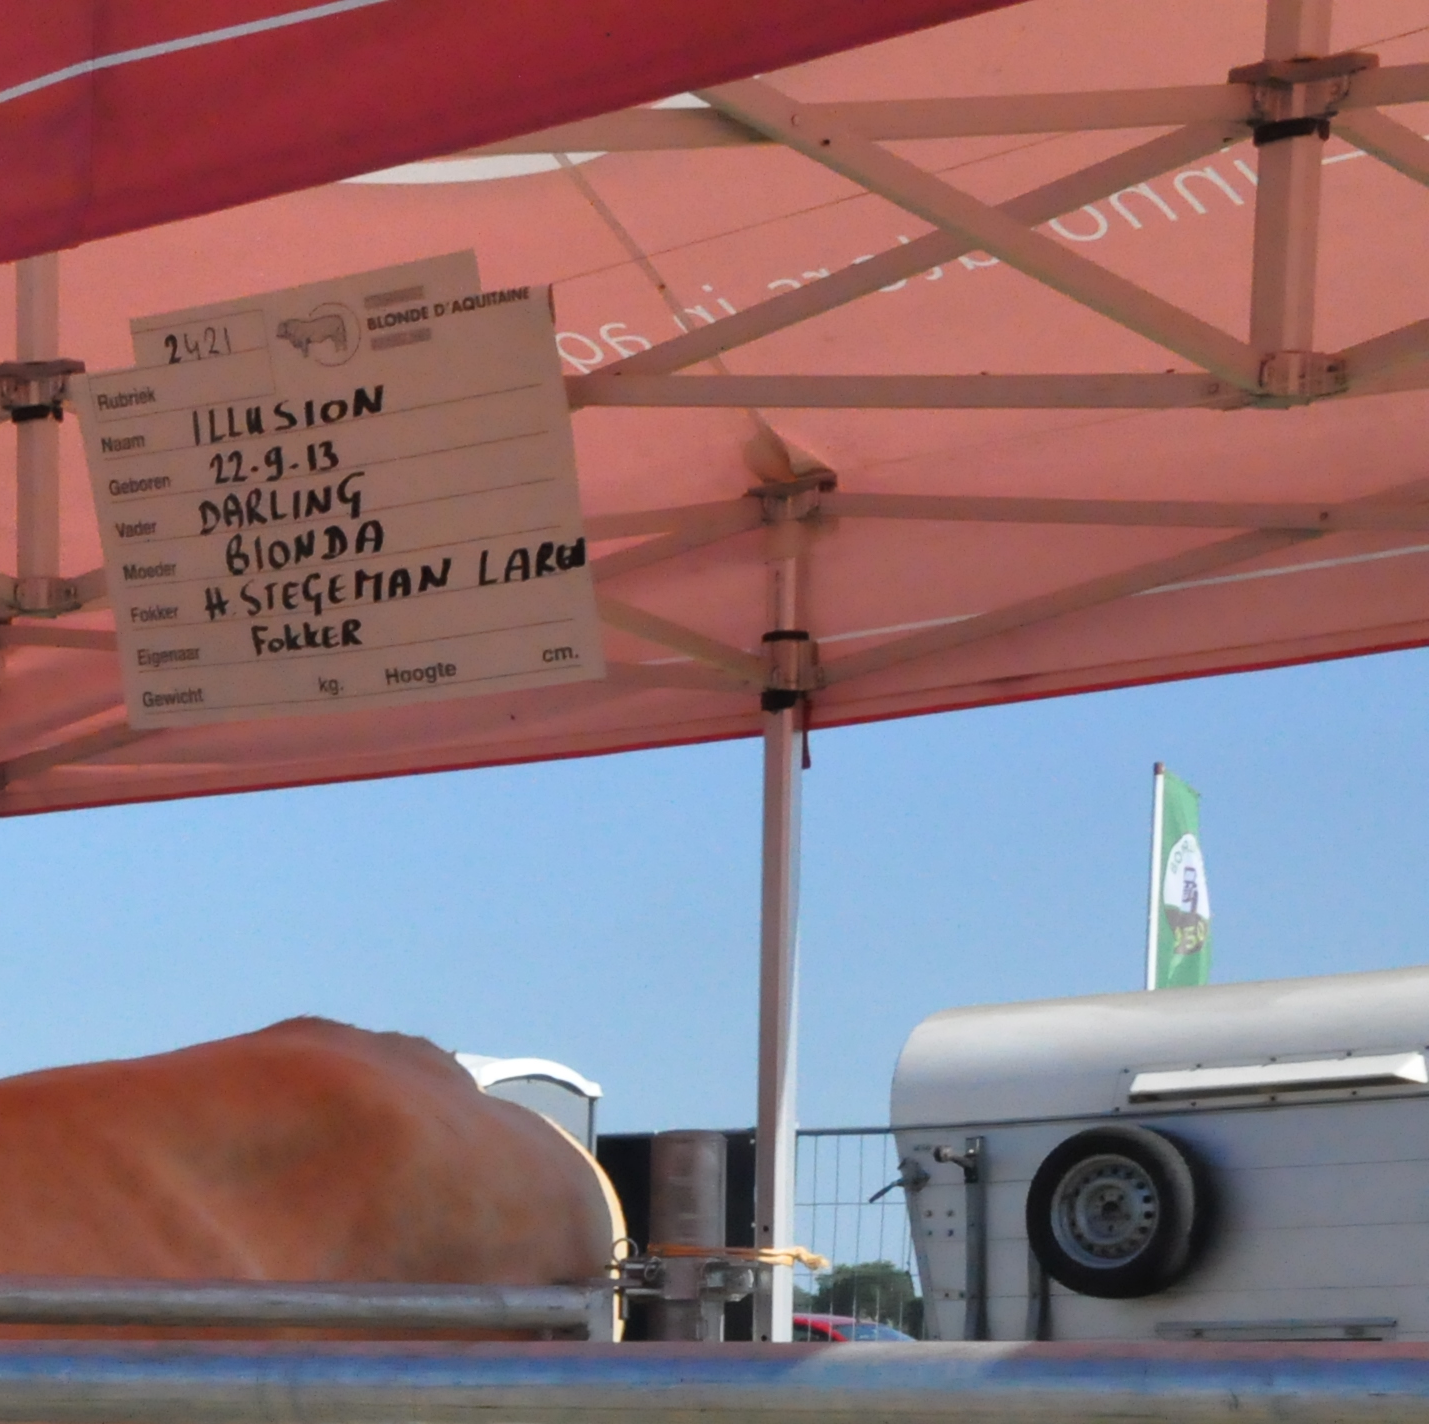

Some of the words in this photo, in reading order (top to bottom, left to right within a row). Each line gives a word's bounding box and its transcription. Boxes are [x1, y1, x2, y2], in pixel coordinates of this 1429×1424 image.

[367, 306, 429, 331] BLONDE
[433, 286, 531, 317] D'AQUITAINE
[164, 326, 232, 364] 2421
[98, 387, 156, 411] Rubriek
[192, 385, 384, 446] ILLUSION
[101, 434, 145, 453] Naam
[109, 474, 171, 496] Geboren
[199, 472, 365, 535] DARLING
[115, 521, 156, 538] Vader
[123, 562, 177, 581] Moeder
[240, 557, 451, 616] STEGEMAN
[130, 605, 179, 623] Fokker
[137, 647, 200, 667] Eigenaar
[142, 688, 204, 708] Gewicht
[385, 662, 457, 685] Hoogte
